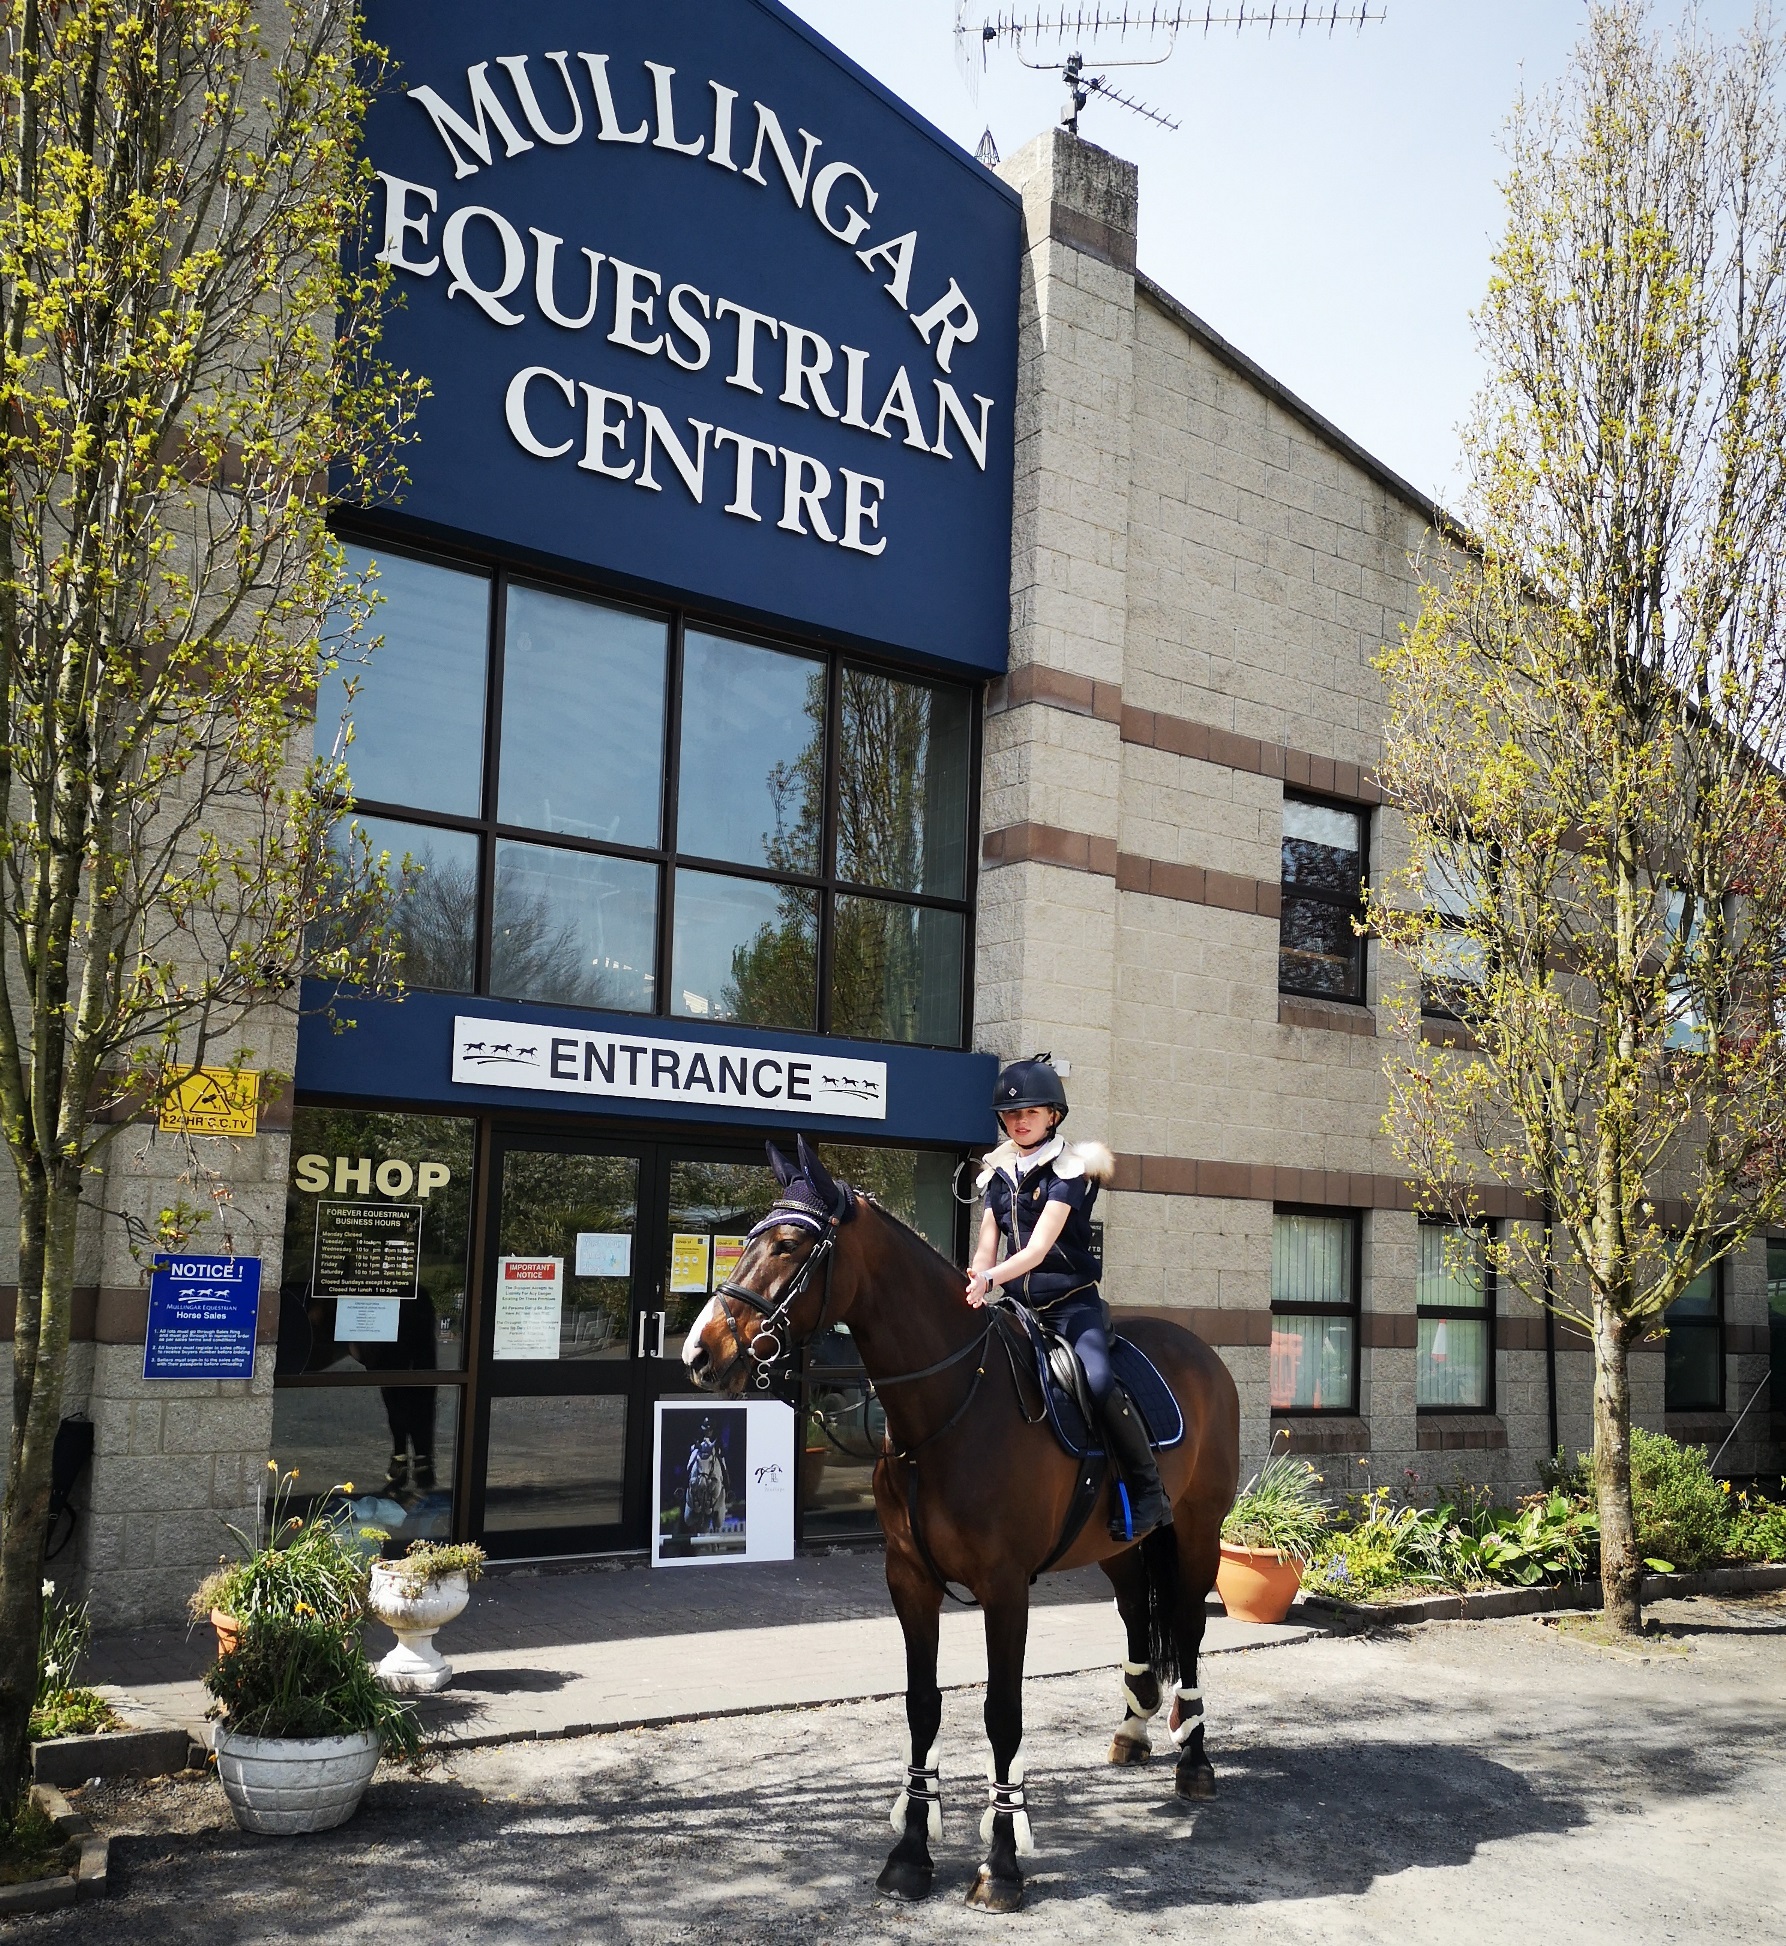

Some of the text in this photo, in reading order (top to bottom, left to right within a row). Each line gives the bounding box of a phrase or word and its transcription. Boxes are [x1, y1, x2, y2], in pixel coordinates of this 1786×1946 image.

[407, 50, 979, 374] MULLINGAR
[375, 170, 994, 471] EQUESTRIAN
[505, 366, 887, 556] CENTRE
[550, 1037, 812, 1101] ENTRANCE
[296, 1154, 450, 1198] SHOP
[326, 1209, 410, 1219] FOREVER EQUESTRIAN
[336, 1218, 373, 1226] BUSINESS
[171, 1263, 233, 1278] NOTICE
